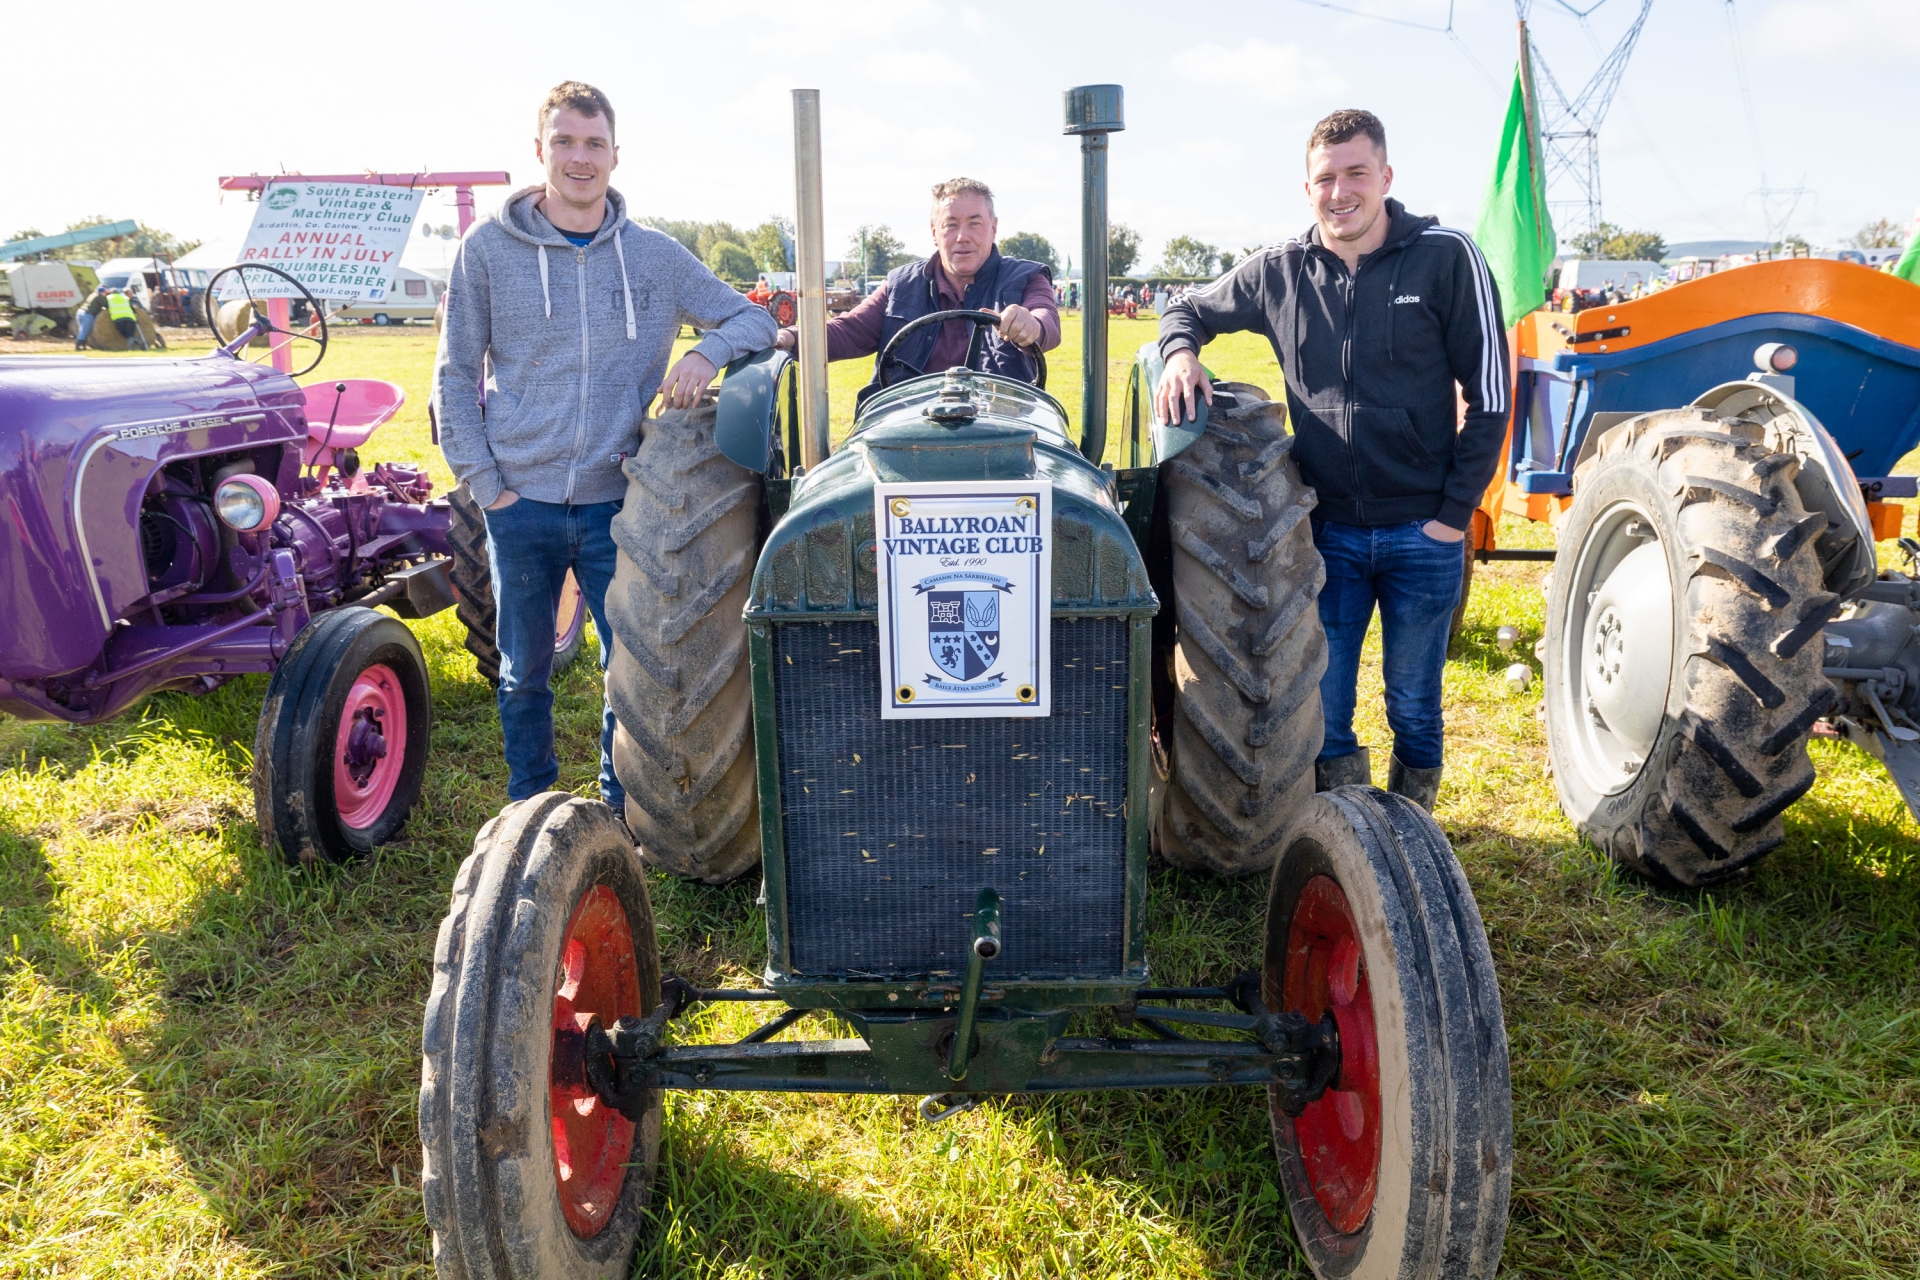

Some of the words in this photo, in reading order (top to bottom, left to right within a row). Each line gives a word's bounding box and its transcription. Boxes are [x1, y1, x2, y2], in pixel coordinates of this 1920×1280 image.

[306, 186, 350, 197] South
[354, 188, 413, 201] Eastern
[319, 198, 376, 211] Vintage
[381, 200, 393, 211] &
[292, 208, 372, 222] Machinery
[376, 212, 411, 224] Club
[324, 222, 361, 230] Carlow.
[278, 232, 366, 246] ANNUAL
[243, 247, 308, 260] RALLY
[310, 247, 336, 259] IN
[340, 248, 394, 263] JULY
[363, 265, 381, 275] IN
[234, 273, 275, 284] APRIL
[296, 273, 386, 287] NOVEMBER
[1394, 294, 1420, 304] didas
[119, 421, 183, 439] PORSCHE
[188, 415, 230, 430] DIESEL
[899, 516, 1027, 534] BALLYROAN
[883, 538, 980, 556] VINTAGE
[985, 537, 1043, 554] CLUB
[940, 557, 960, 567] Estd.
[964, 557, 987, 566] 1990
